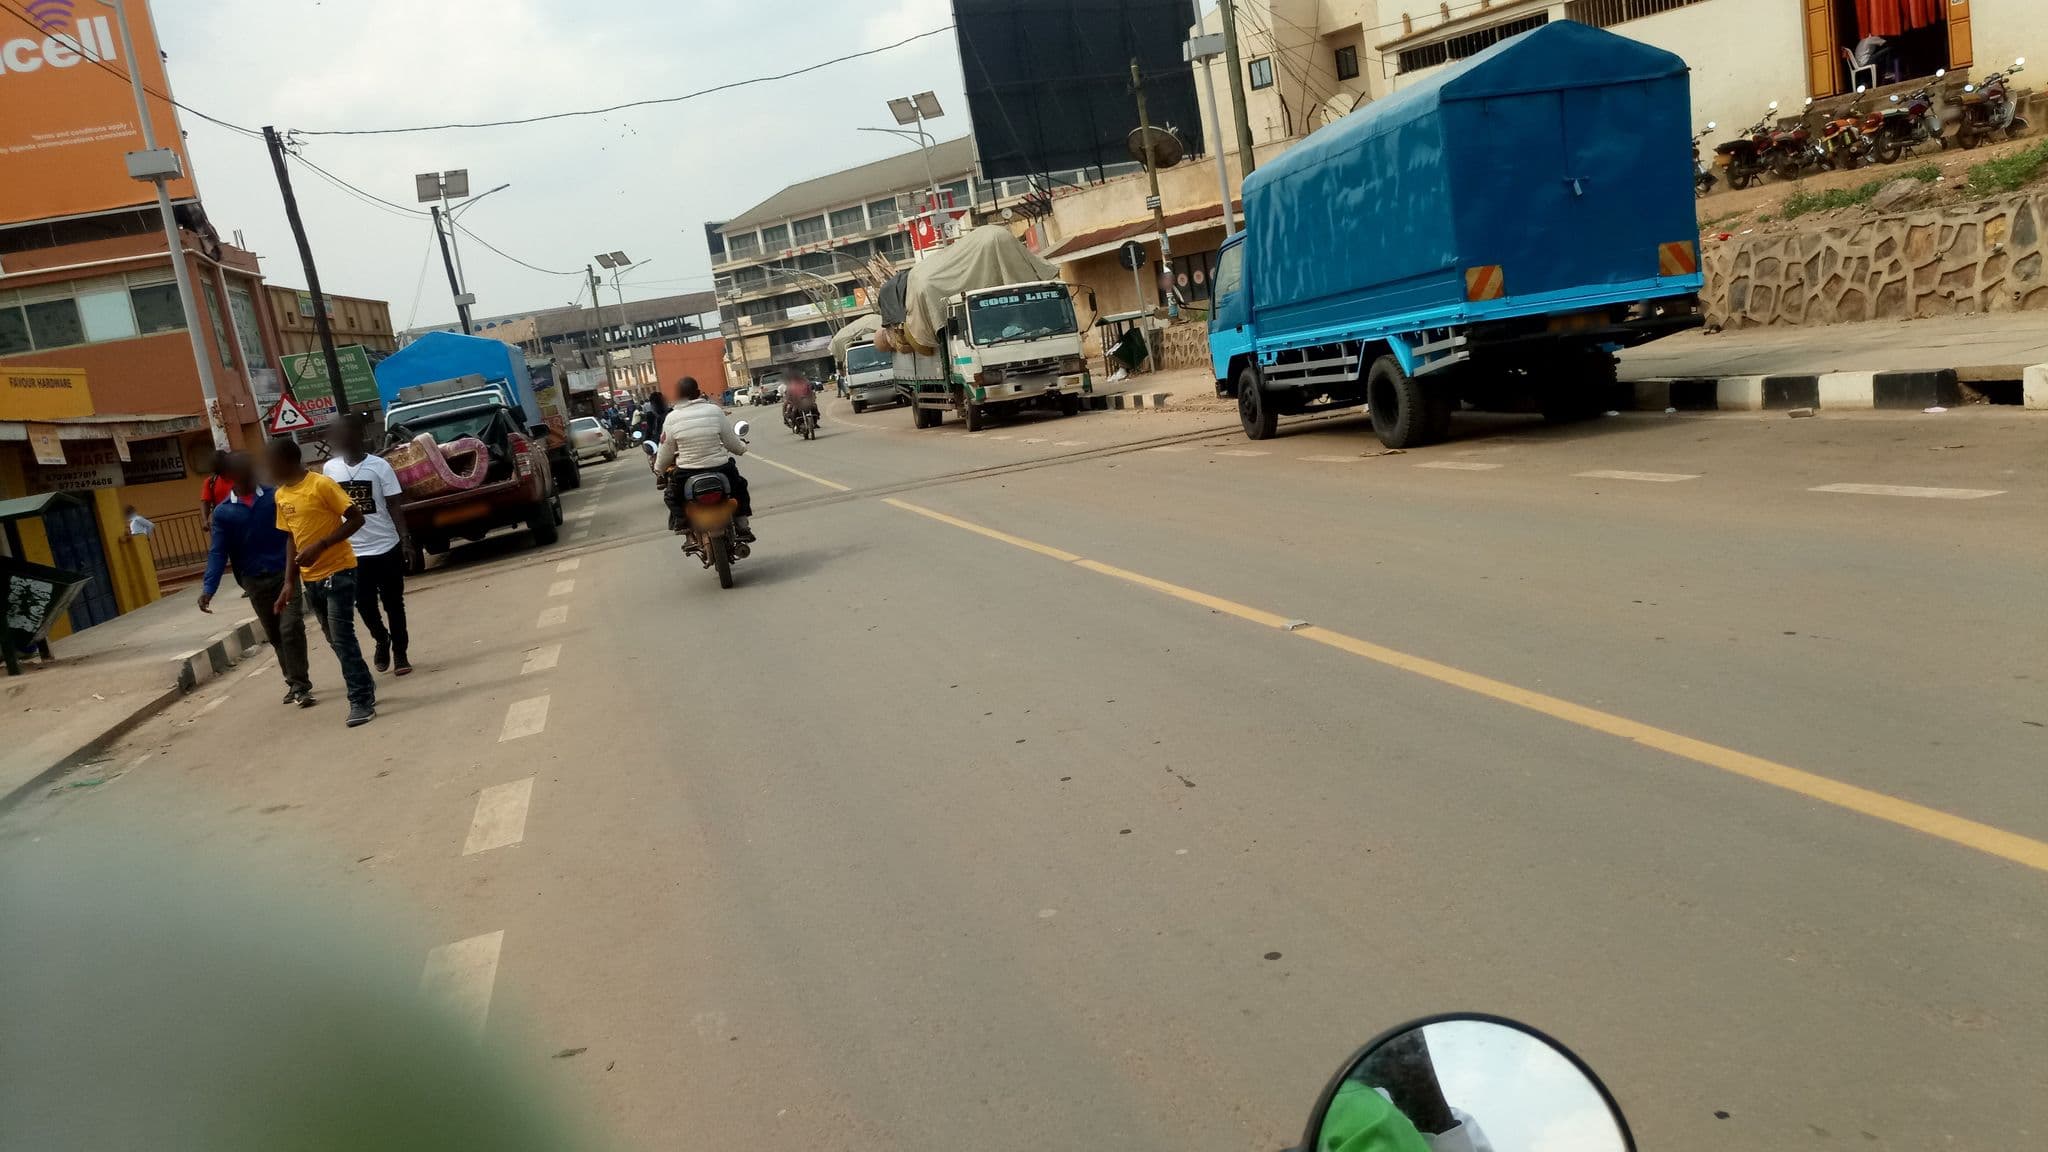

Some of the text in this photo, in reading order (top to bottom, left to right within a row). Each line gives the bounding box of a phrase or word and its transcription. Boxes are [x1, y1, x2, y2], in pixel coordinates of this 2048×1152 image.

[0, 16, 117, 75] cell
[979, 291, 1060, 307] GOOD LIFE
[313, 352, 355, 367] Gowill
[9, 377, 73, 389] FAVOUR HARDWARE
[300, 396, 333, 411] AGON
